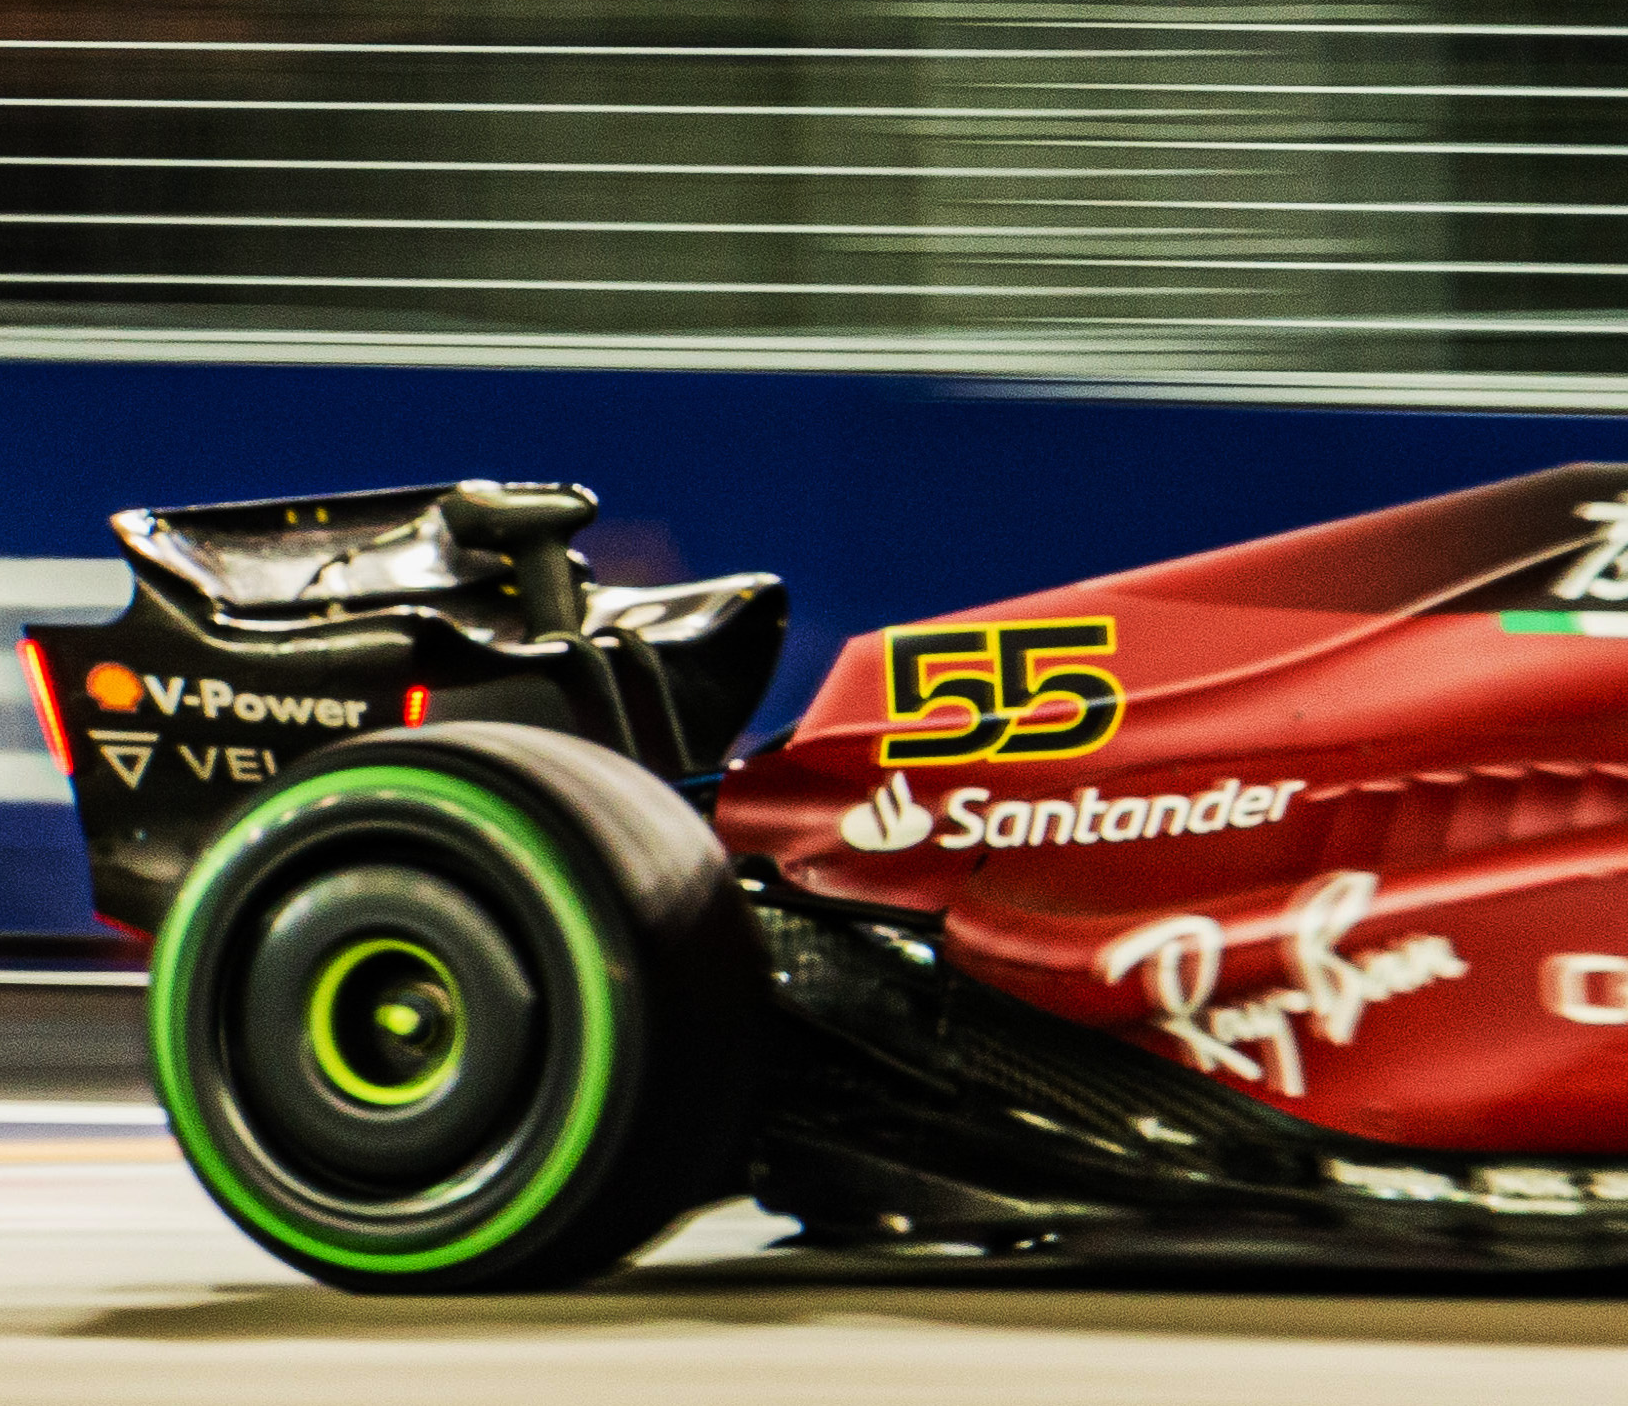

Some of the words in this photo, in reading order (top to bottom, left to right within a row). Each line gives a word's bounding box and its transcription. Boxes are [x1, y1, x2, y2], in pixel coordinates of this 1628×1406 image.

[143, 674, 369, 728] V-Power
[880, 615, 1126, 767] 55
[939, 779, 1307, 849] Santander
